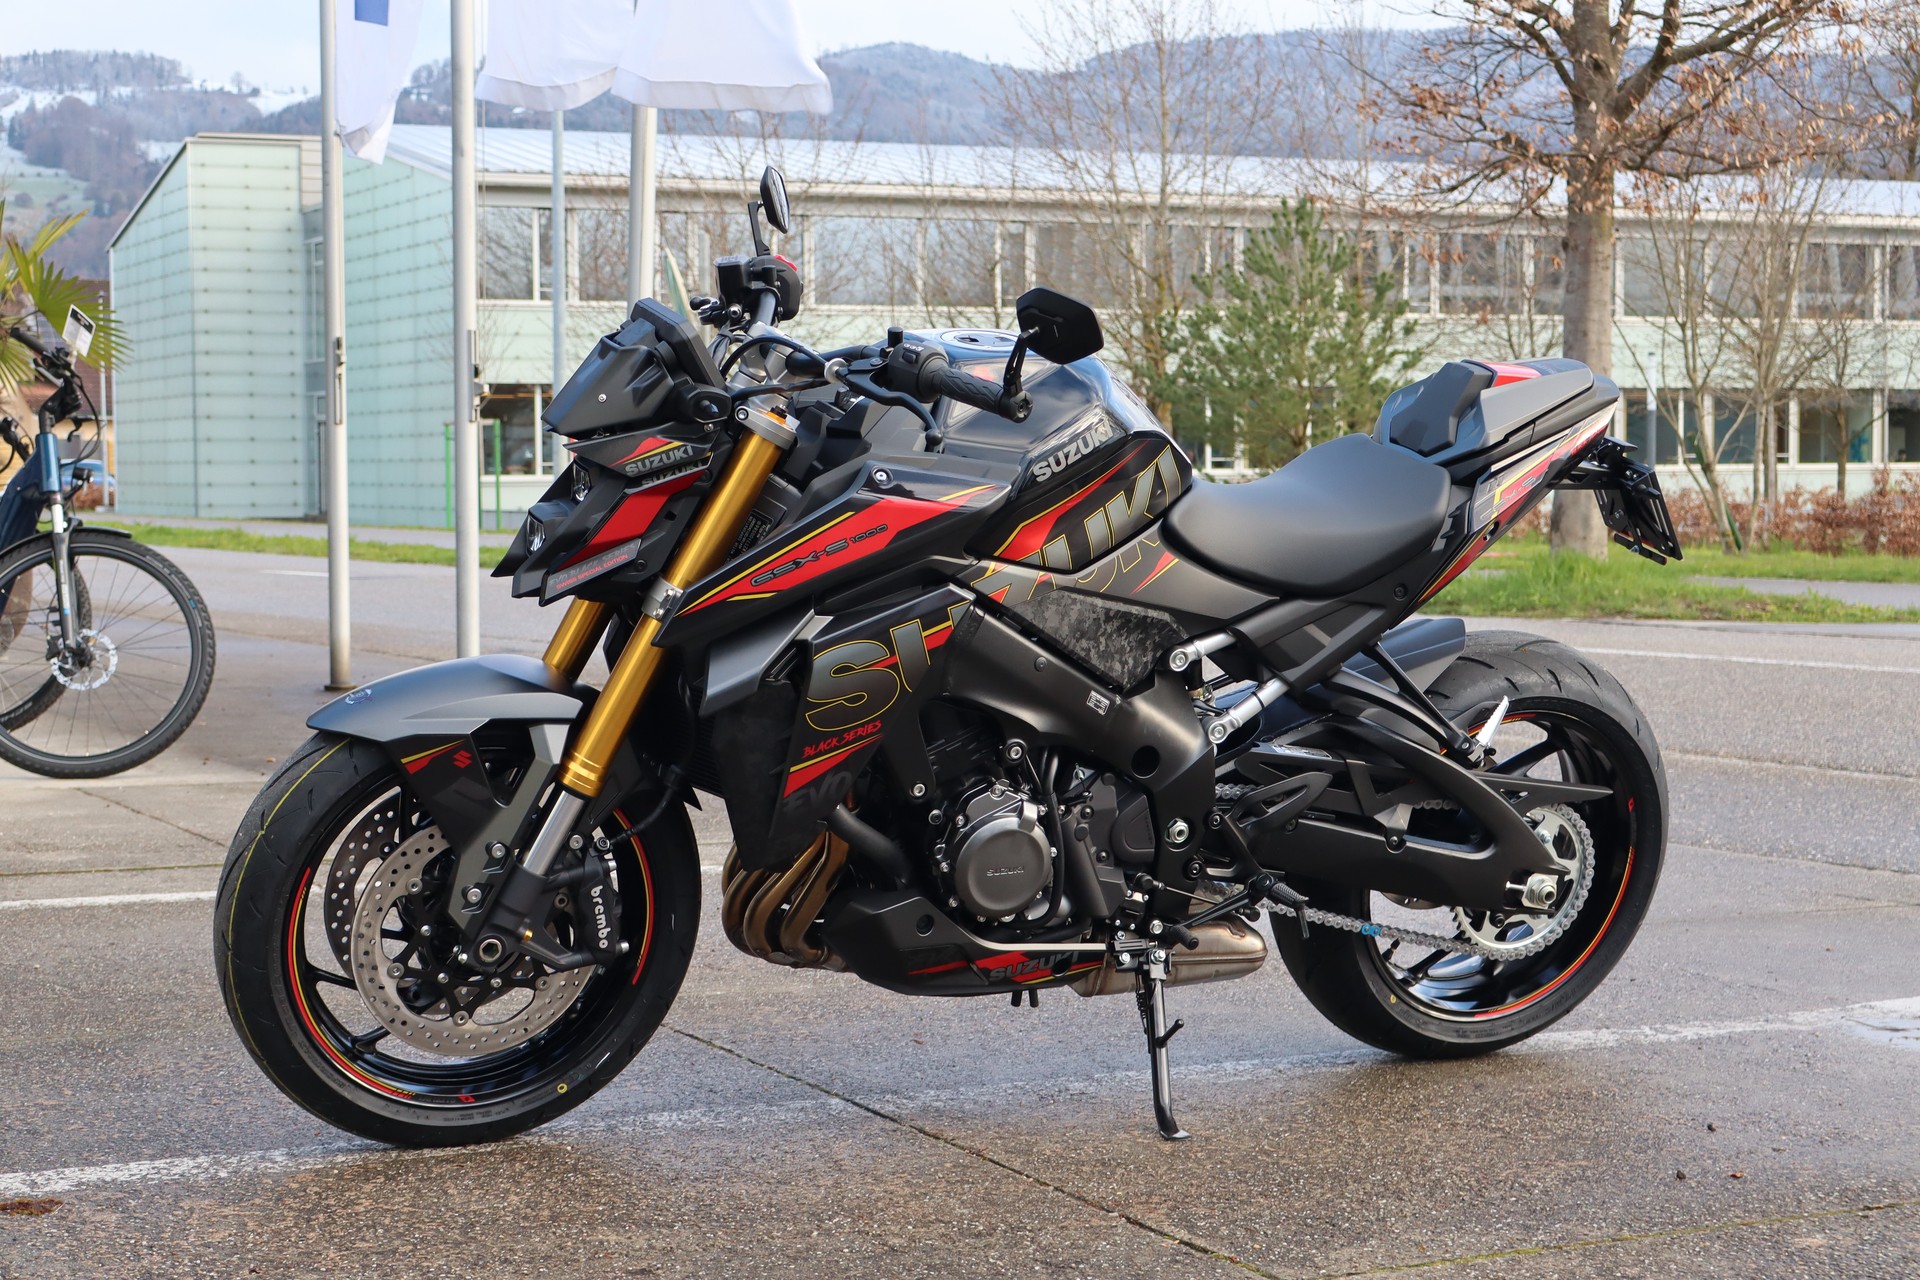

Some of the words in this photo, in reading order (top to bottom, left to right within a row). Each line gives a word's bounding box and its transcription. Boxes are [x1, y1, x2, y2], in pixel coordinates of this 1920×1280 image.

[625, 445, 694, 477] SUZUKI
[1032, 421, 1113, 482] SUZUKI
[556, 576, 578, 590] SWISS
[577, 565, 602, 581] SPECIAL
[603, 553, 629, 569] EDITION
[751, 539, 849, 586] GSX-S
[850, 524, 888, 544] 1000
[801, 738, 841, 759] BLACK
[840, 720, 883, 745] SERIES
[986, 866, 1024, 877] SUZUKI
[590, 885, 612, 949] brembo
